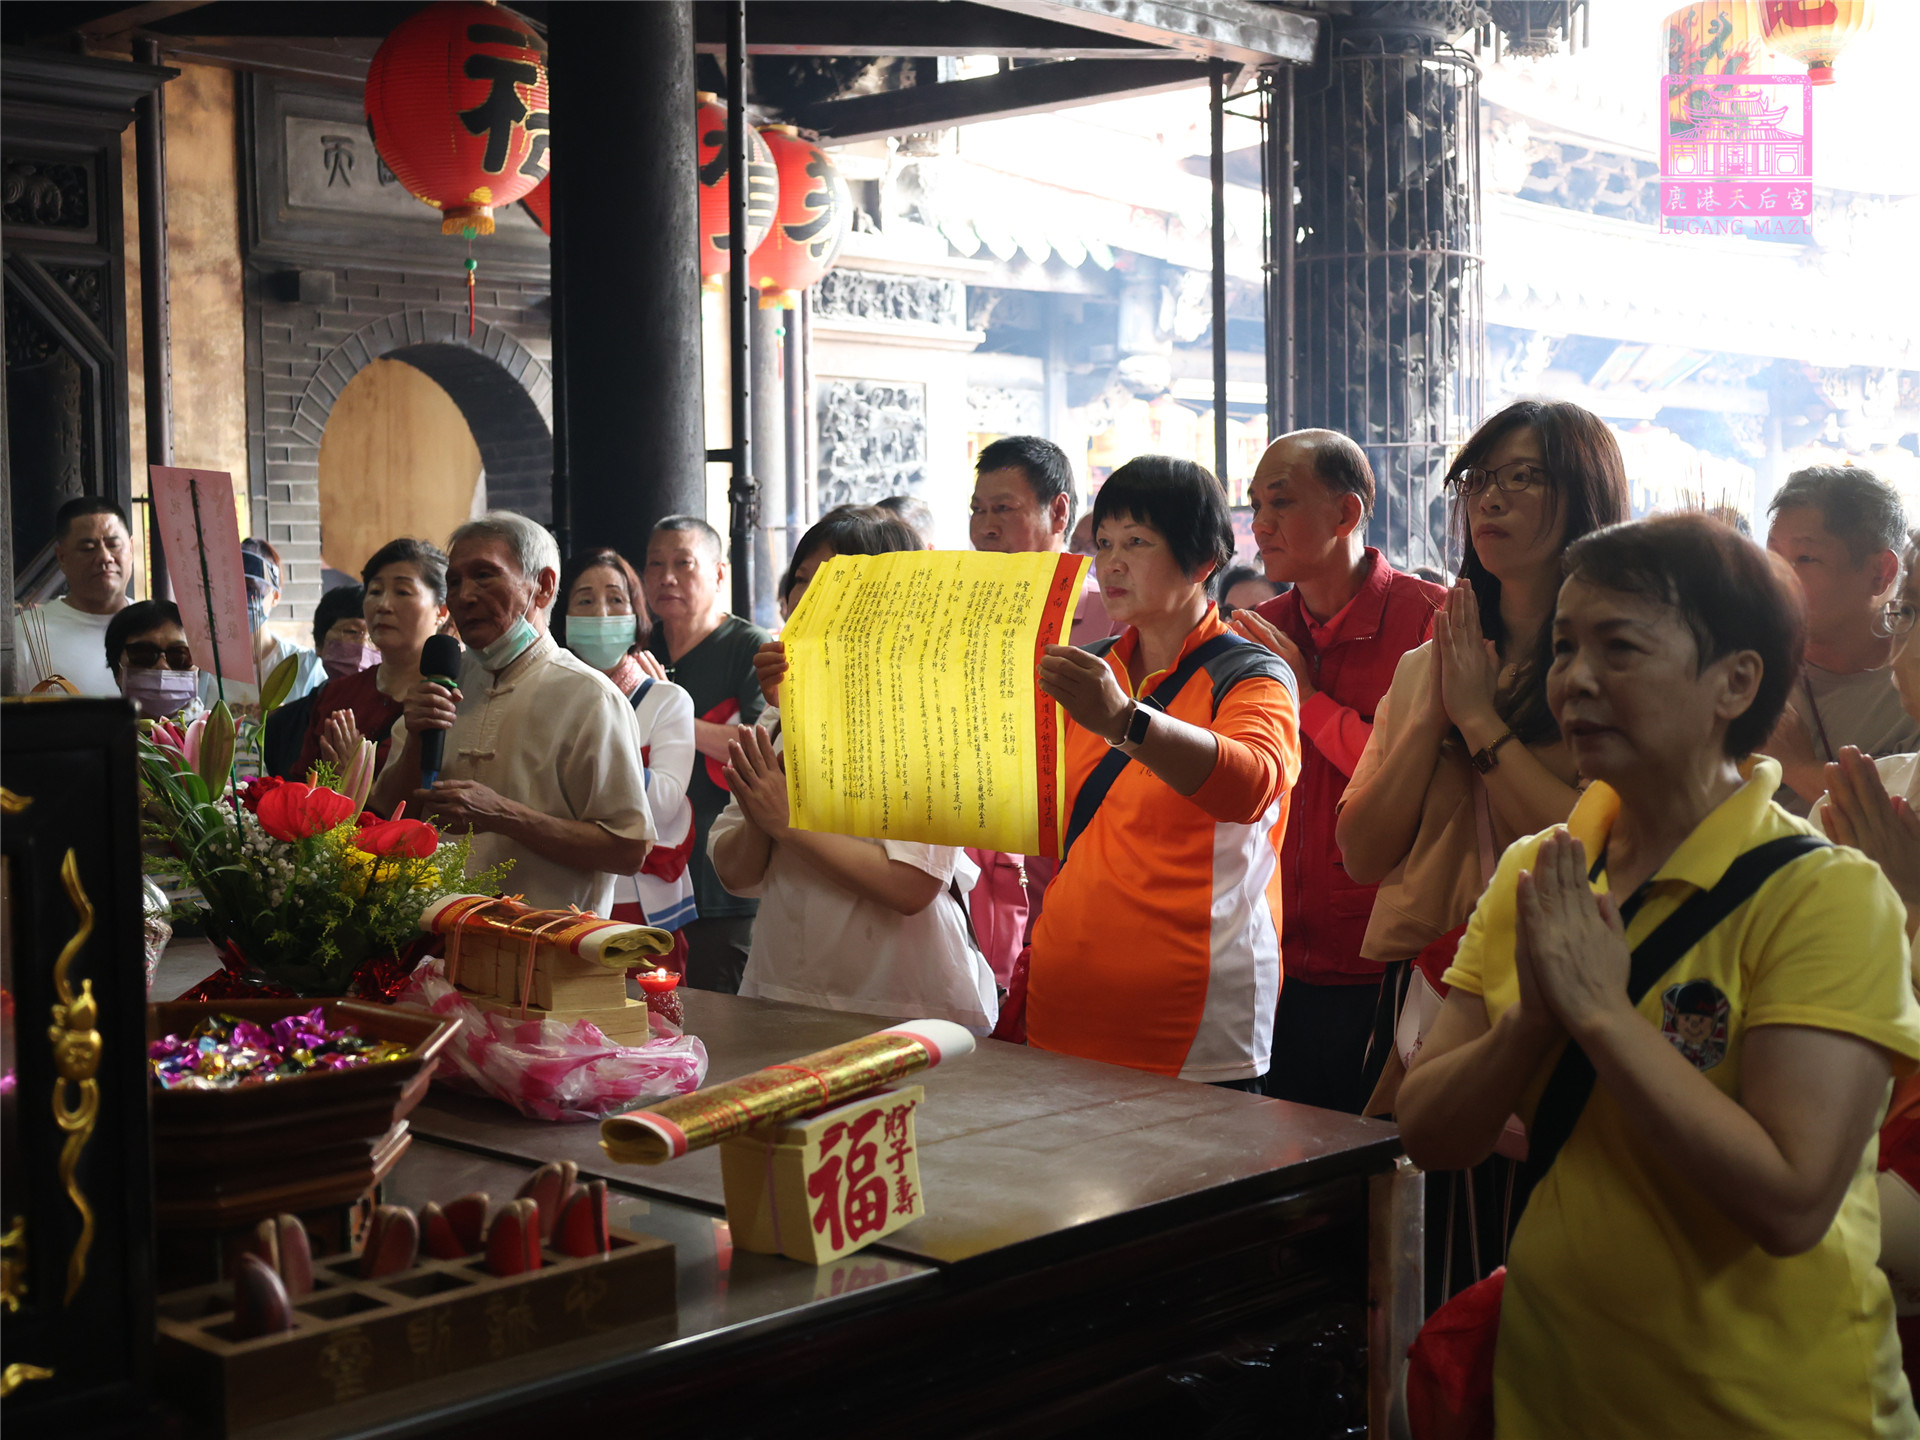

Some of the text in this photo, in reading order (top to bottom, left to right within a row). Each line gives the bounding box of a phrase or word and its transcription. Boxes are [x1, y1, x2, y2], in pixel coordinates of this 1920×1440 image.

[807, 1108, 889, 1251] 福
[884, 1099, 917, 1216] 財子壽
